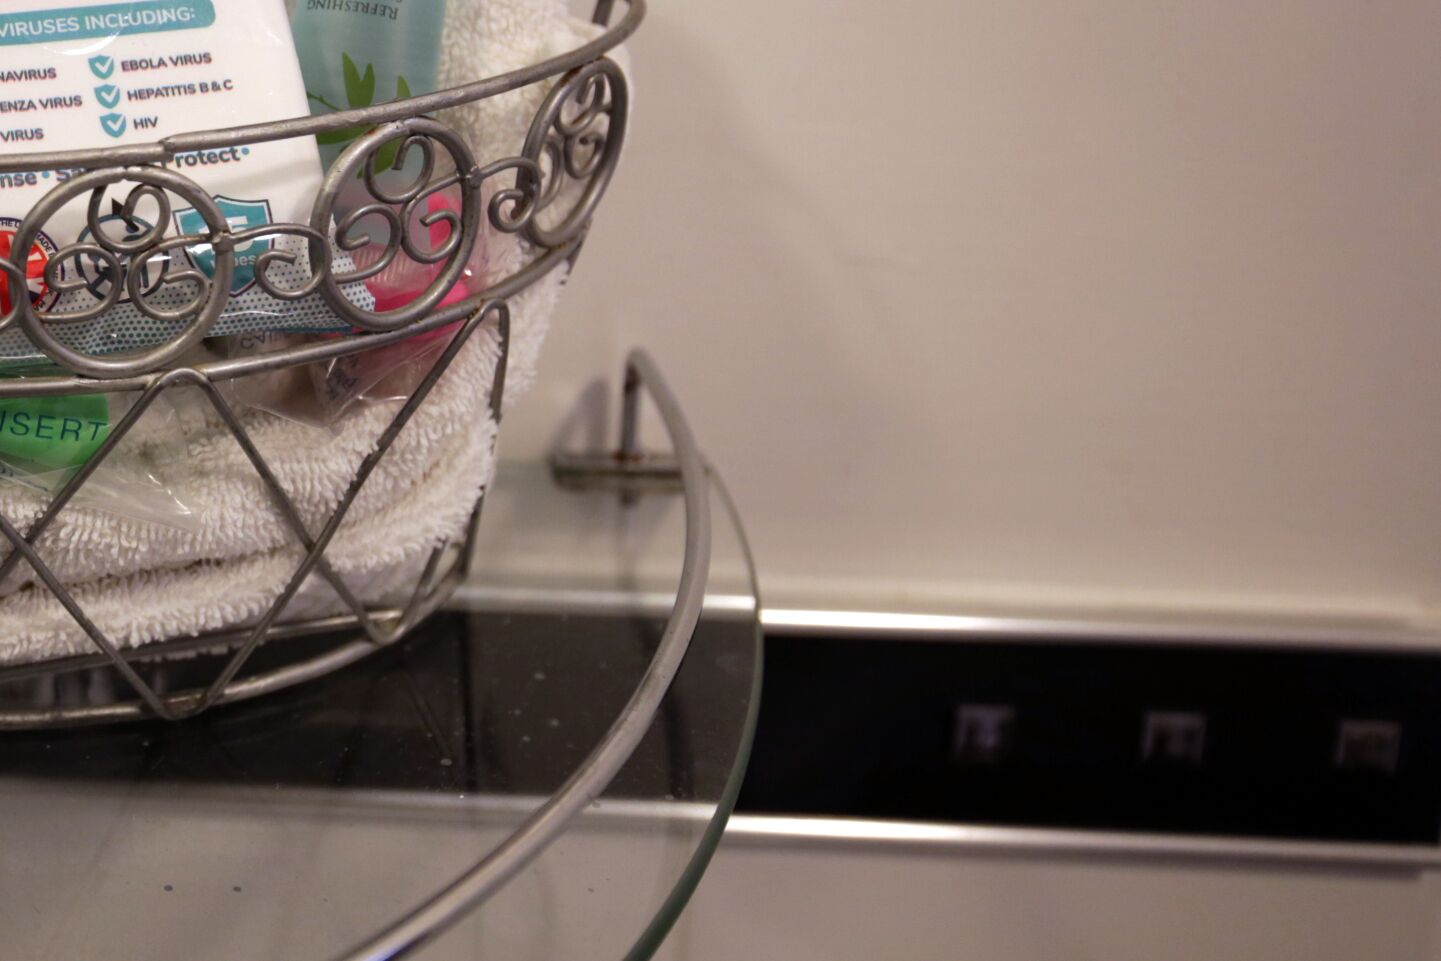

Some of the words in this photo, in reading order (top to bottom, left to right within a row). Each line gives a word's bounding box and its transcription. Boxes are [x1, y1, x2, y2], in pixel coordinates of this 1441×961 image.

[84, 6, 196, 30] INCLUDING:
[120, 56, 167, 73] EBOLA
[168, 51, 213, 68] VIRUS
[126, 84, 197, 102] HEPATITIS
[198, 81, 210, 94] B
[222, 78, 234, 91] C
[39, 95, 84, 111] VIRUS
[132, 115, 159, 131] HIV
[0, 127, 45, 144] VIRUS
